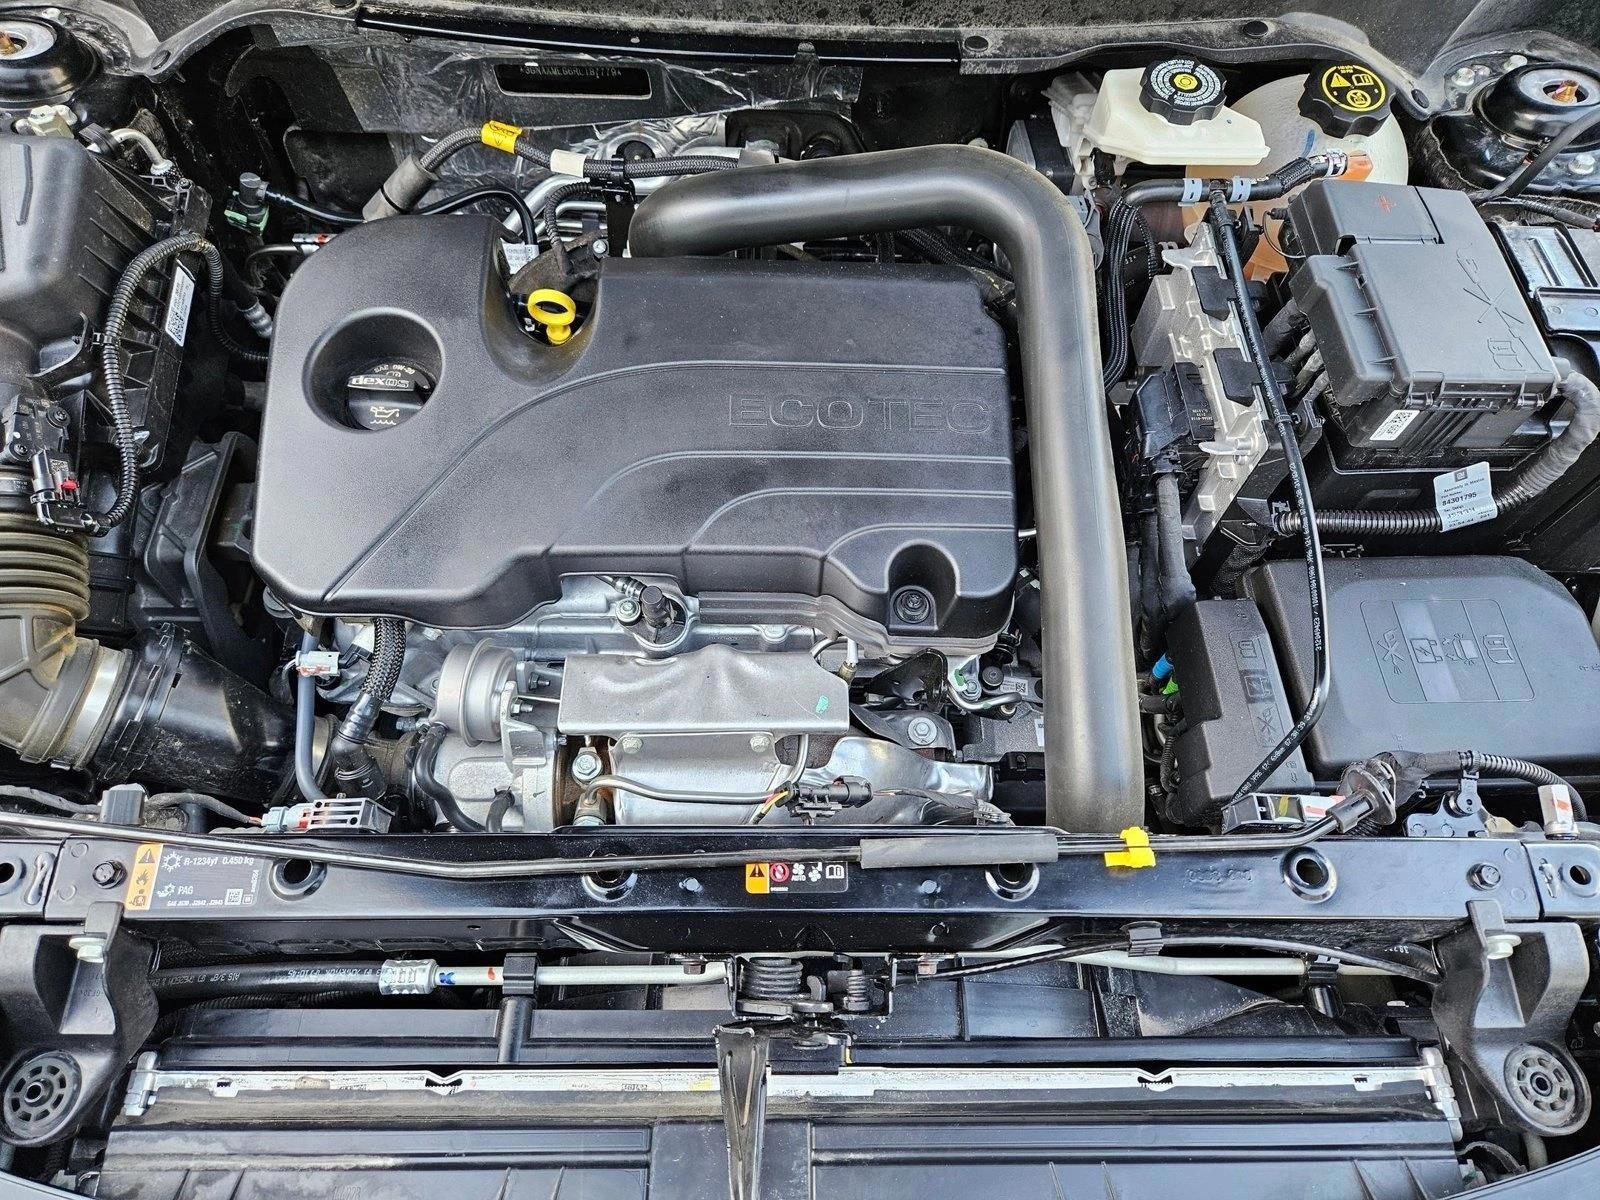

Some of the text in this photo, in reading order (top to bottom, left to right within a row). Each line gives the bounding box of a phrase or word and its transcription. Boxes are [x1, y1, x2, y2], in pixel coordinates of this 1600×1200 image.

[351, 375, 410, 389] dexos
[729, 395, 992, 434] ECOTEC
[1442, 492, 1477, 506] 84301795
[184, 857, 219, 867] R-1234yf
[178, 885, 194, 895] PAG
